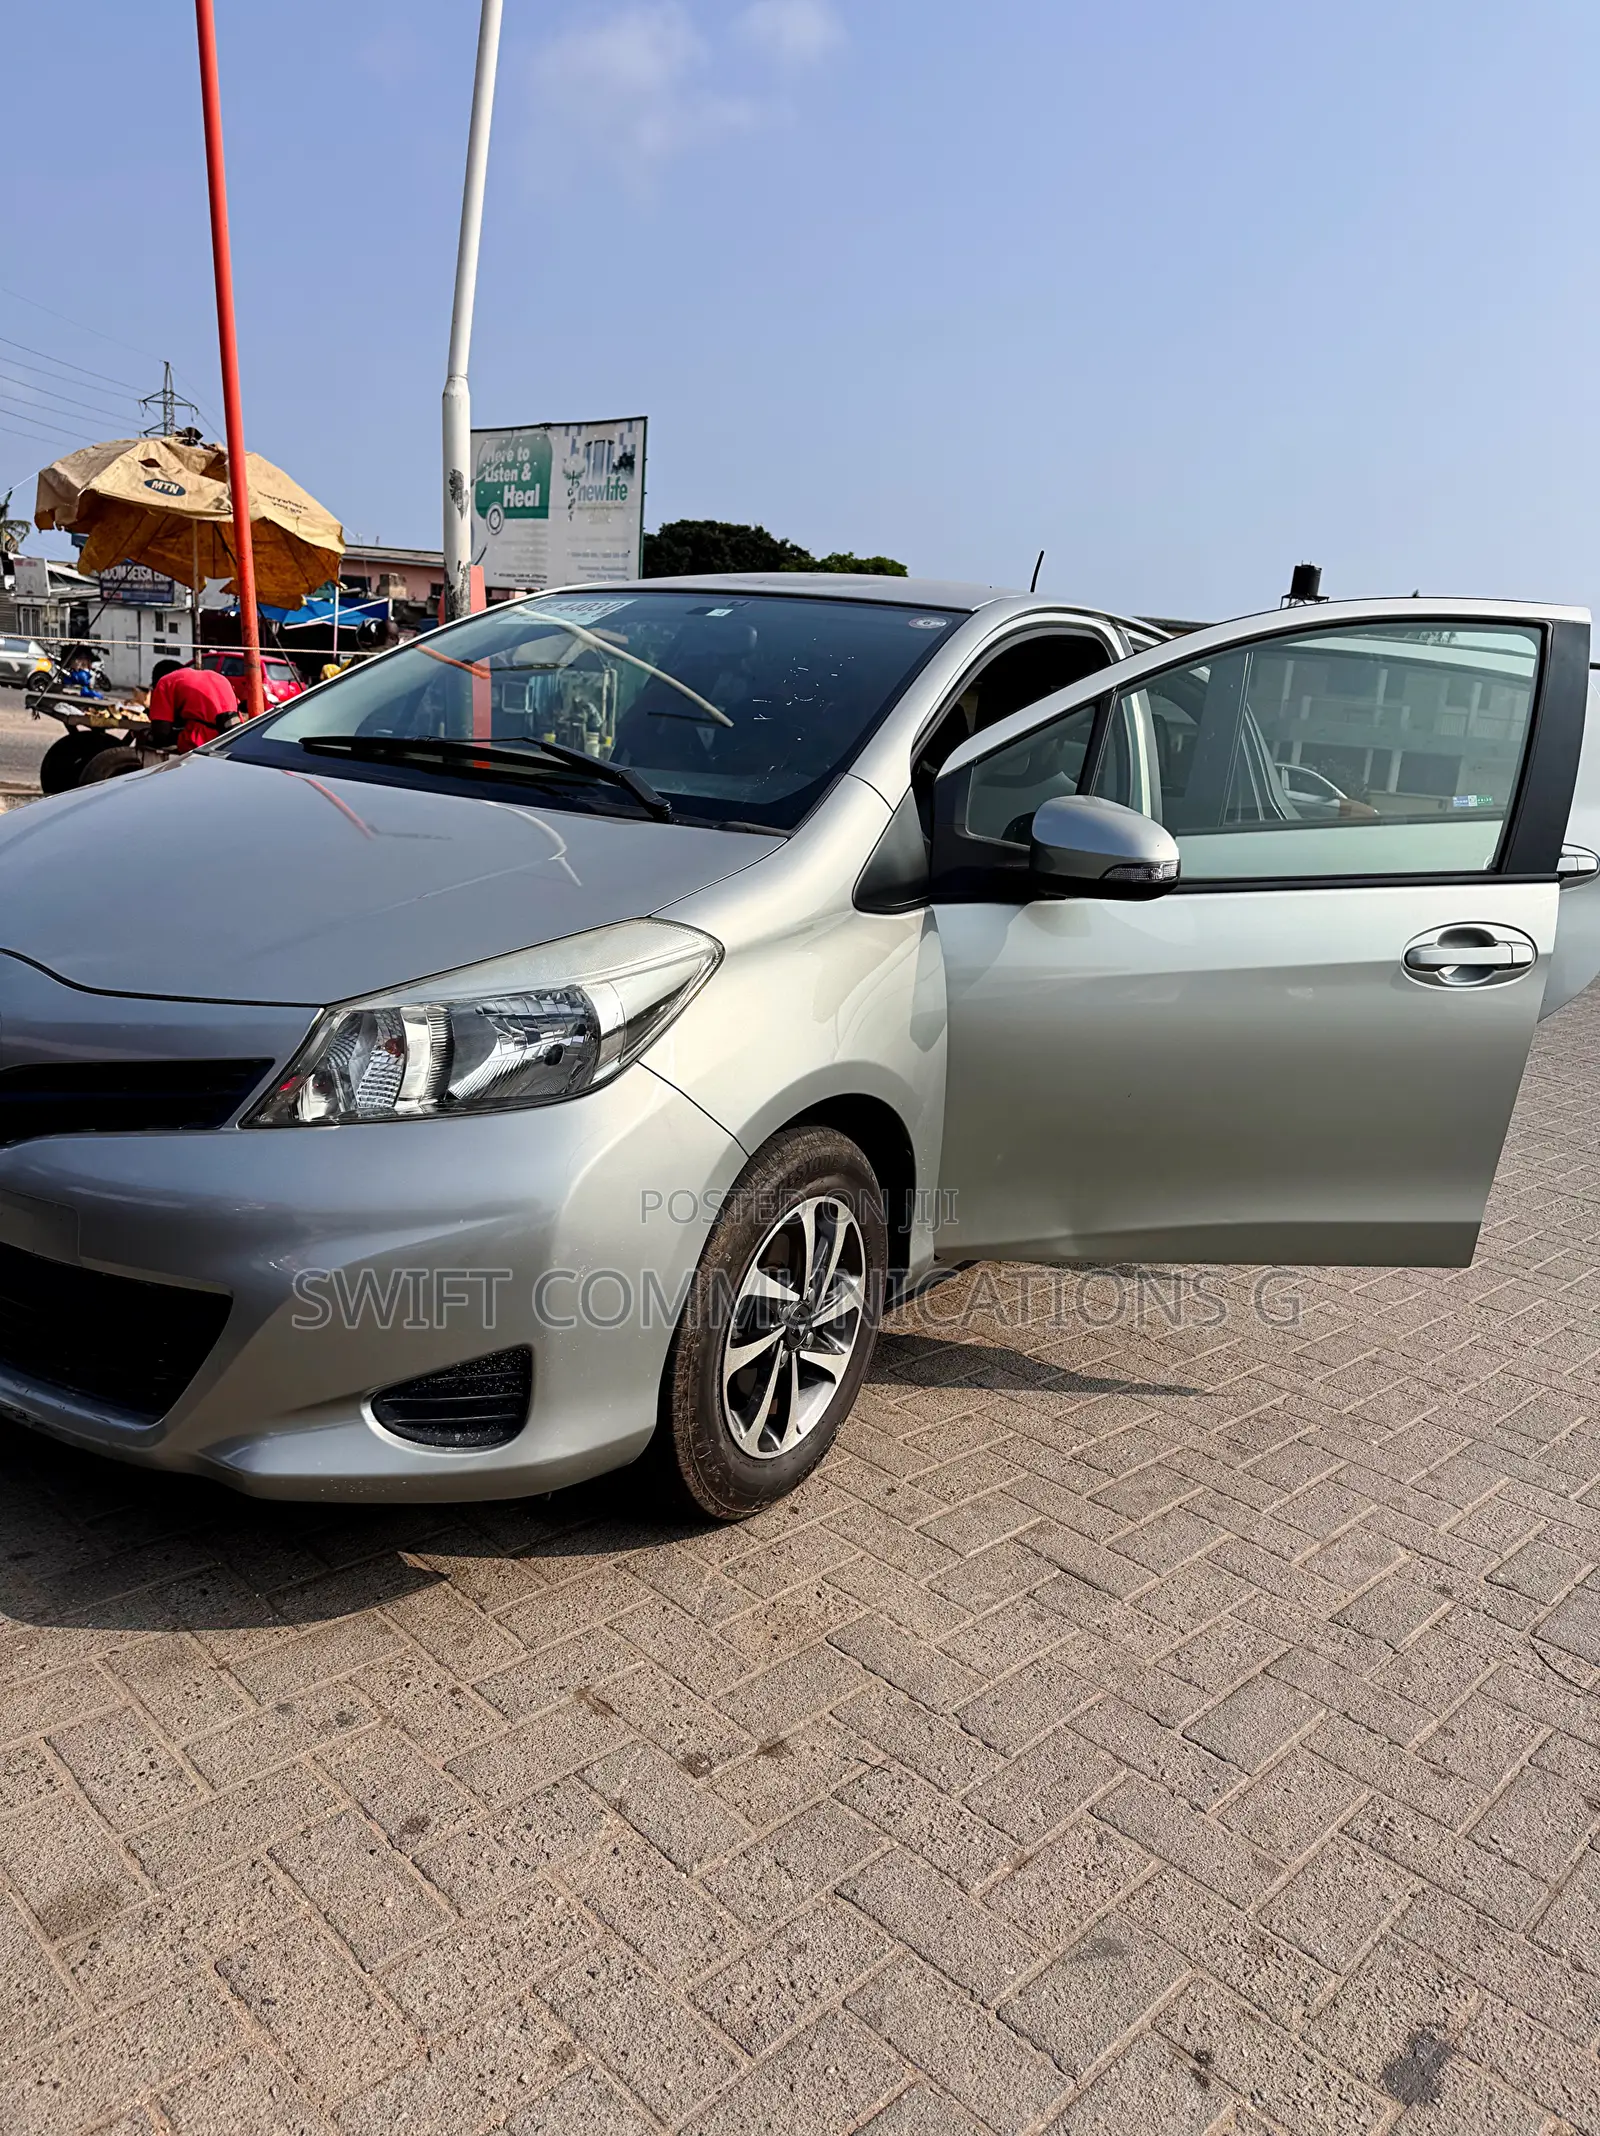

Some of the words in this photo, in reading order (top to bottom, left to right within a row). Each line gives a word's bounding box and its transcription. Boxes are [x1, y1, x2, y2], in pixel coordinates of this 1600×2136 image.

[486, 446, 514, 462] Here
[517, 447, 530, 461] to
[485, 465, 518, 482] Listen
[521, 463, 531, 481] &
[151, 480, 180, 494] MTN
[503, 483, 540, 508] Heal
